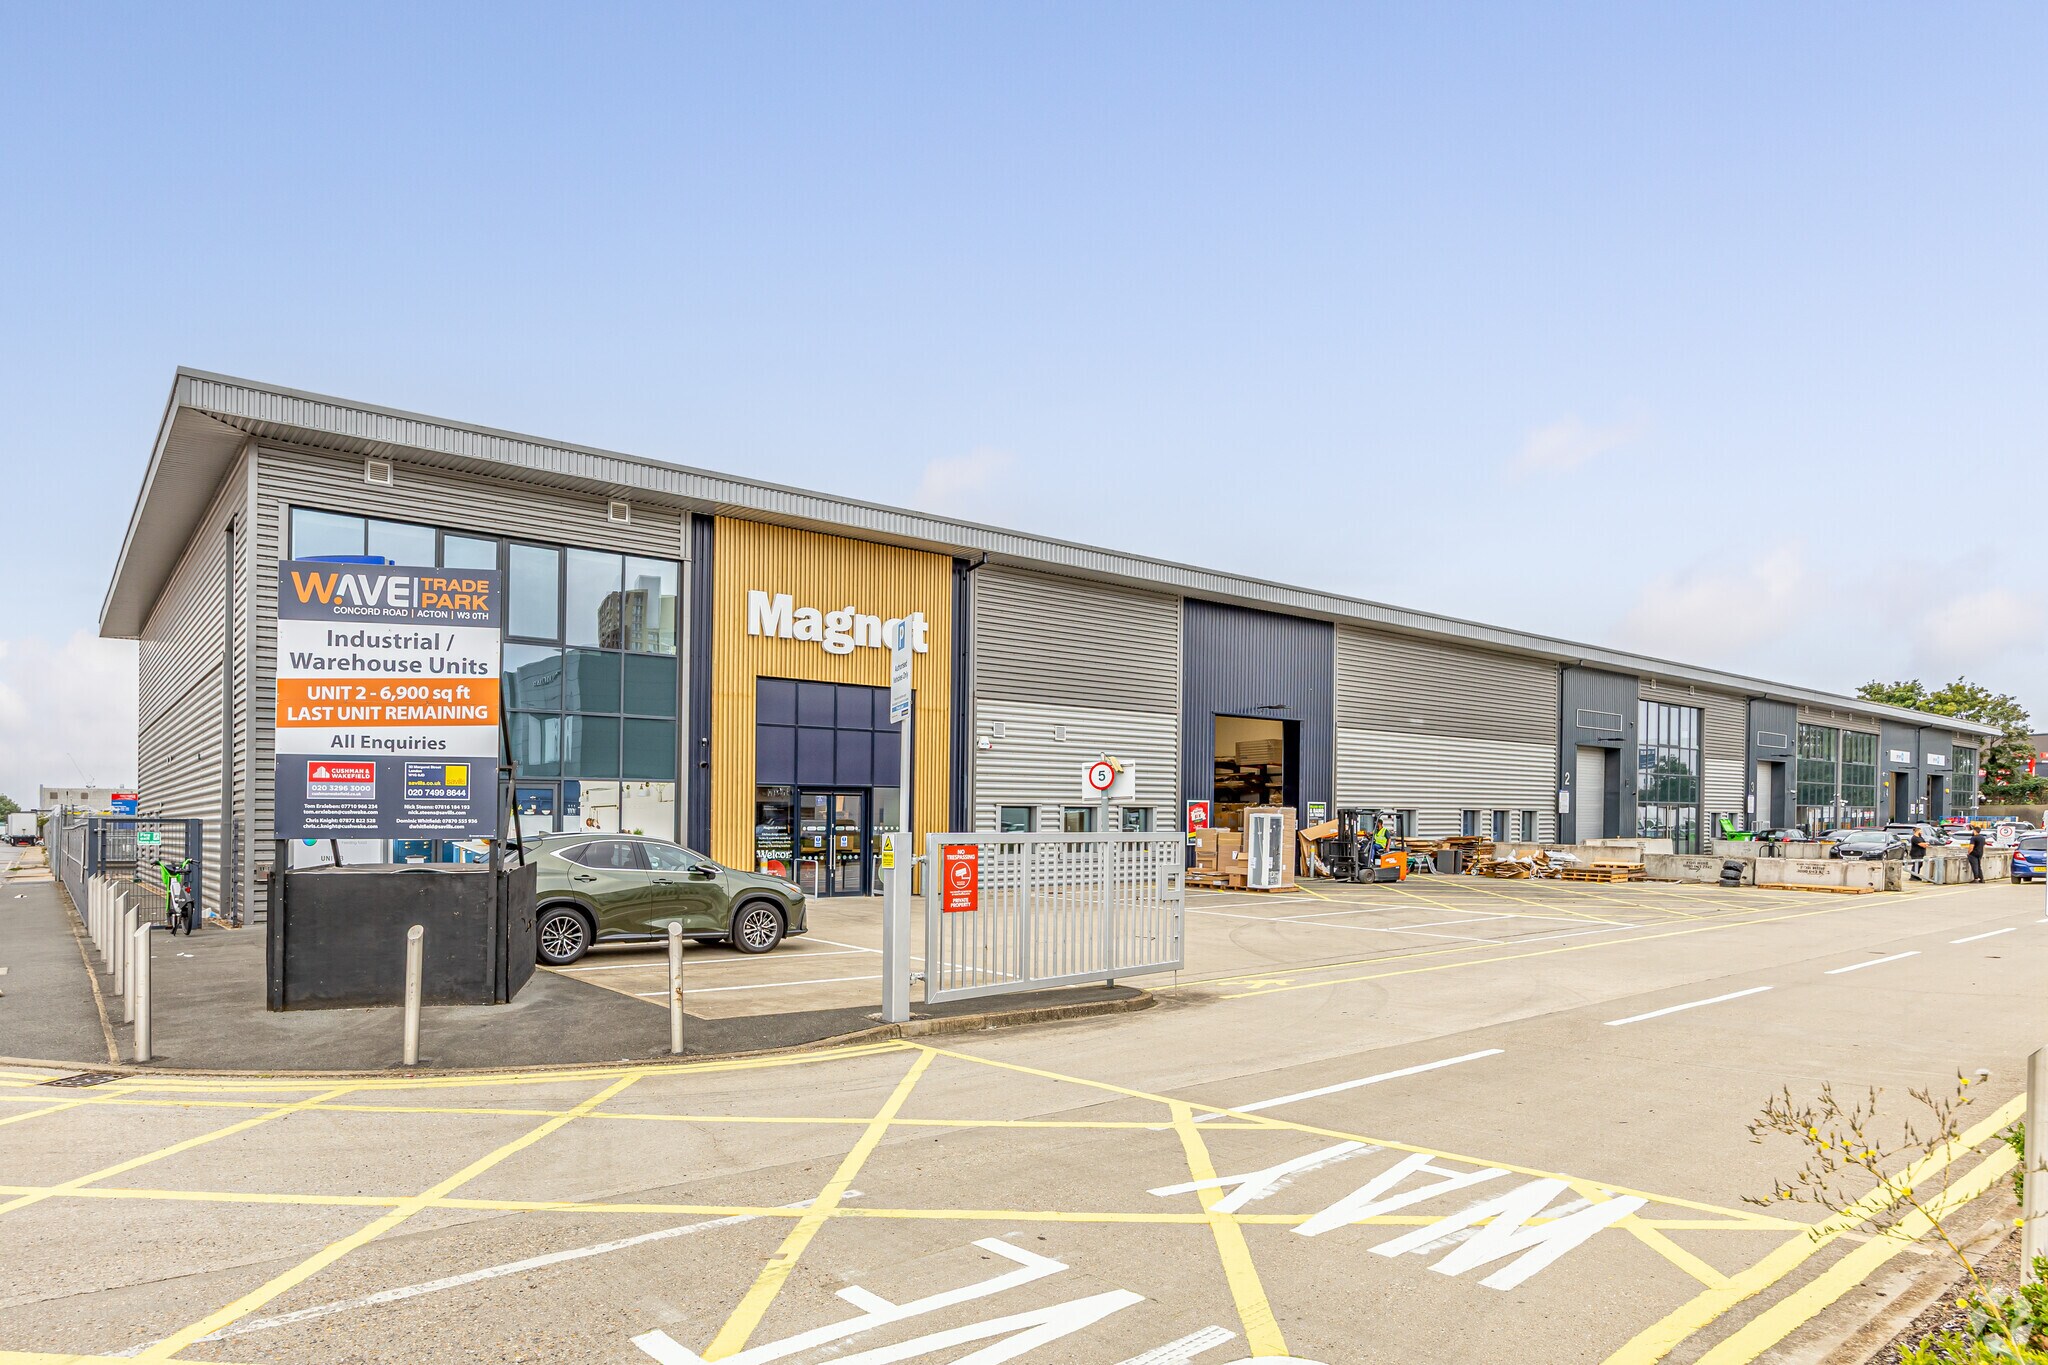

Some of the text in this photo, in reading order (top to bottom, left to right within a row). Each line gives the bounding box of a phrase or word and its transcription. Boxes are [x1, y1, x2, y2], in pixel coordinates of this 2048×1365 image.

[421, 577, 489, 593] TRADE
[422, 593, 489, 611] PARK
[333, 607, 489, 620] CONCORD ROAD ACTON W3 0TH
[327, 630, 440, 650] Industrial
[290, 652, 489, 675] Warehouse Units
[307, 685, 352, 700] UNIT
[355, 686, 366, 700] 2
[380, 686, 429, 702] 6,900
[432, 689, 452, 703] sq
[456, 685, 470, 699] ft
[287, 705, 488, 721] LAST UNIT REMAINING
[330, 734, 447, 752] All Enquiries
[1098, 770, 1106, 781] 5
[1564, 772, 1570, 785] 2
[1750, 782, 1754, 792] 3
[1146, 1140, 1649, 1291] WAY
